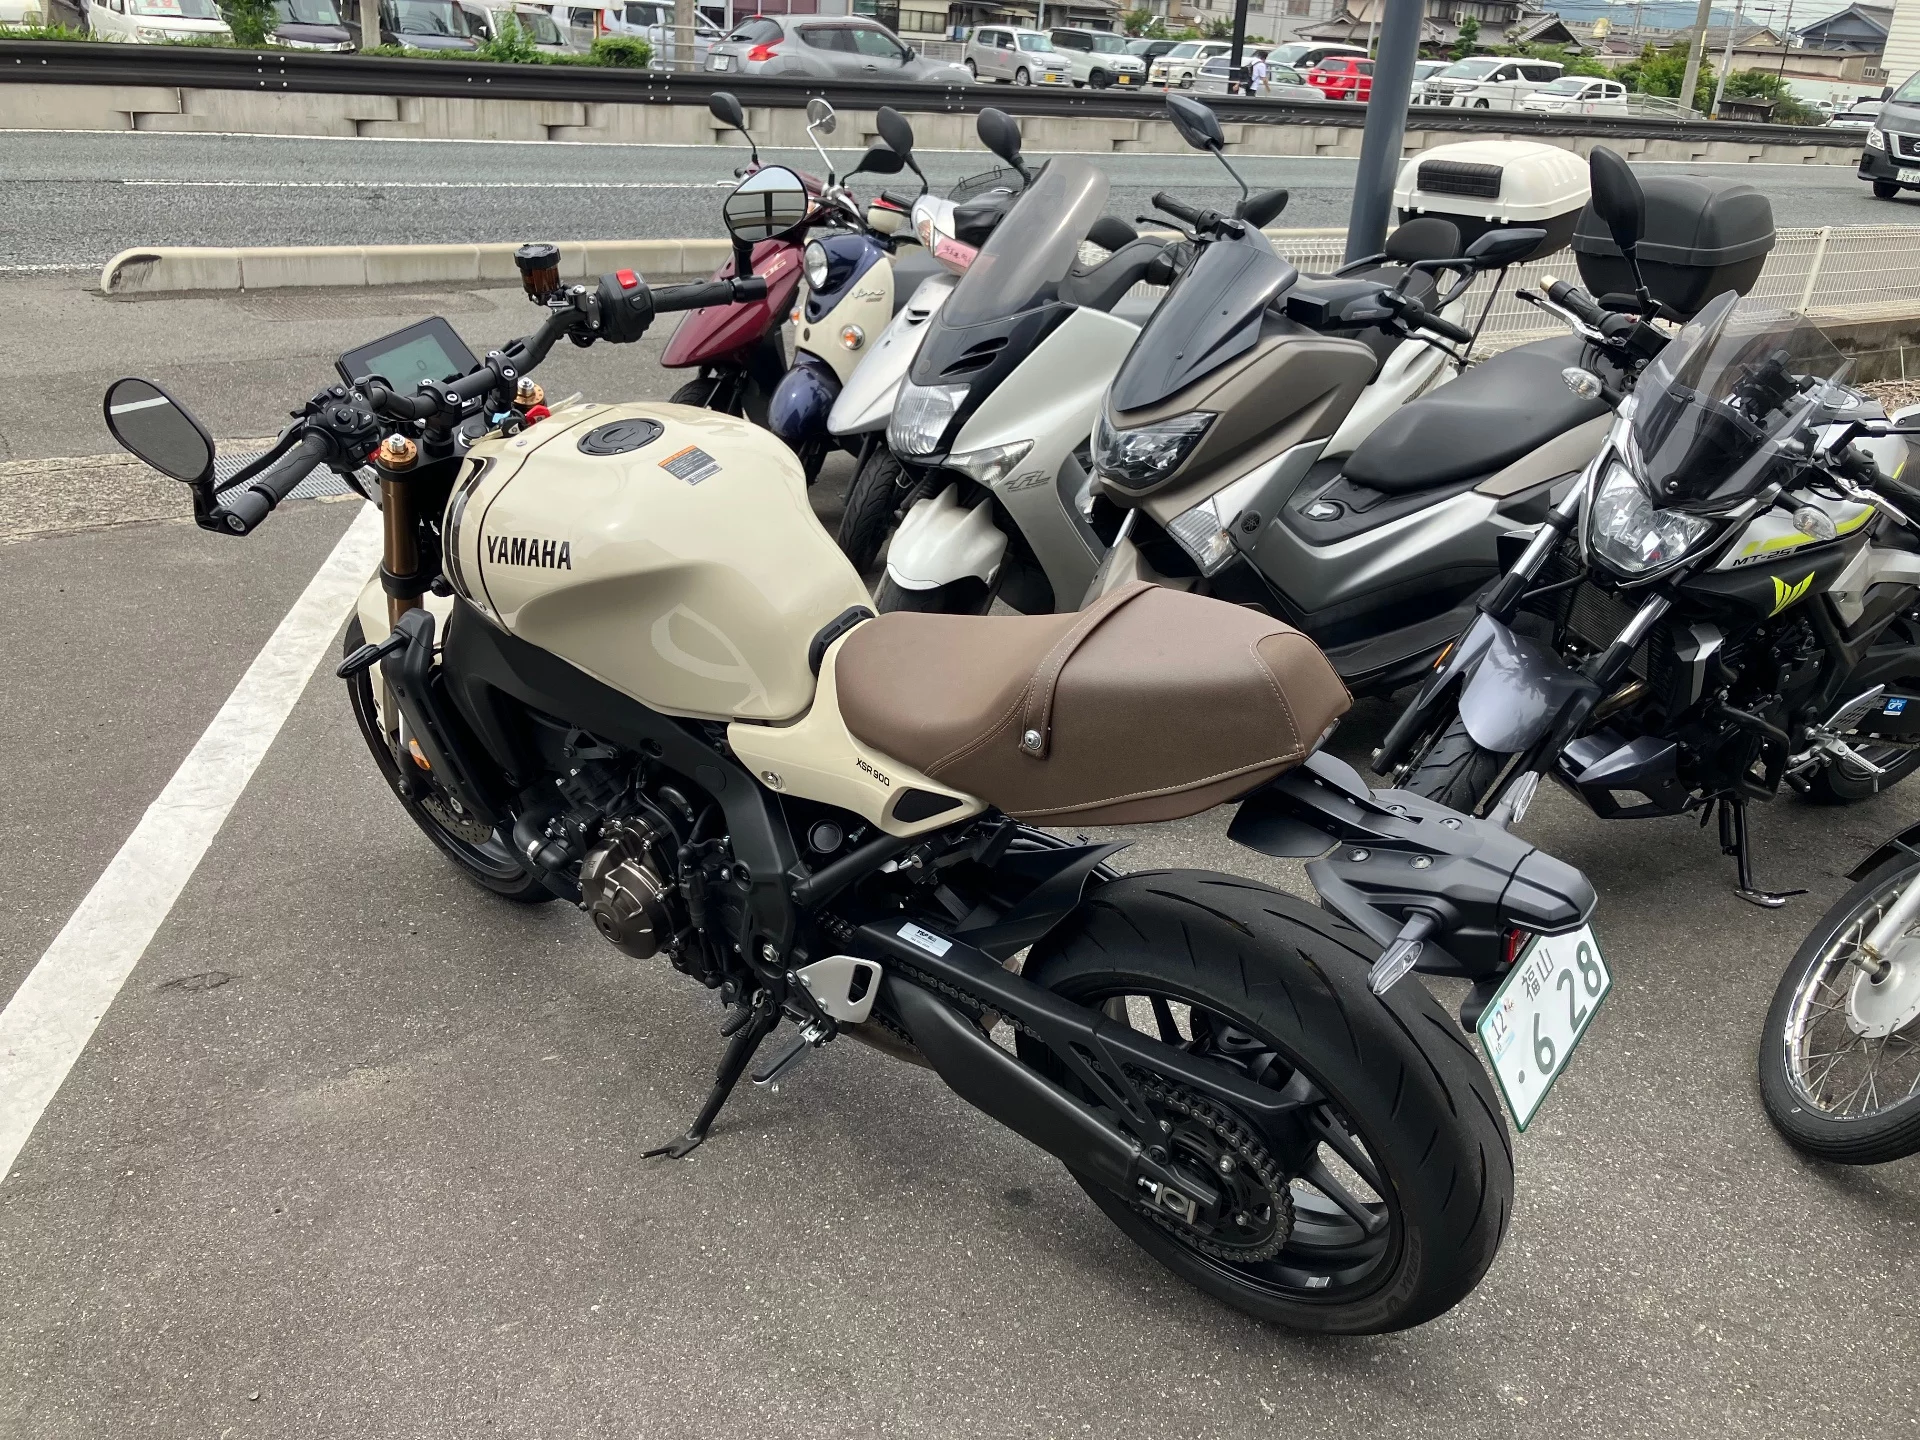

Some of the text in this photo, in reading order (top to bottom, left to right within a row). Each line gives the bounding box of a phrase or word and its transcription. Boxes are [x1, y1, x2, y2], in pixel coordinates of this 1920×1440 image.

[487, 535, 572, 570] YAMAHA
[1732, 547, 1793, 566] MT-25
[855, 757, 890, 787] XSR 900
[1521, 948, 1555, 1002] 福山
[1491, 1009, 1508, 1041] 12
